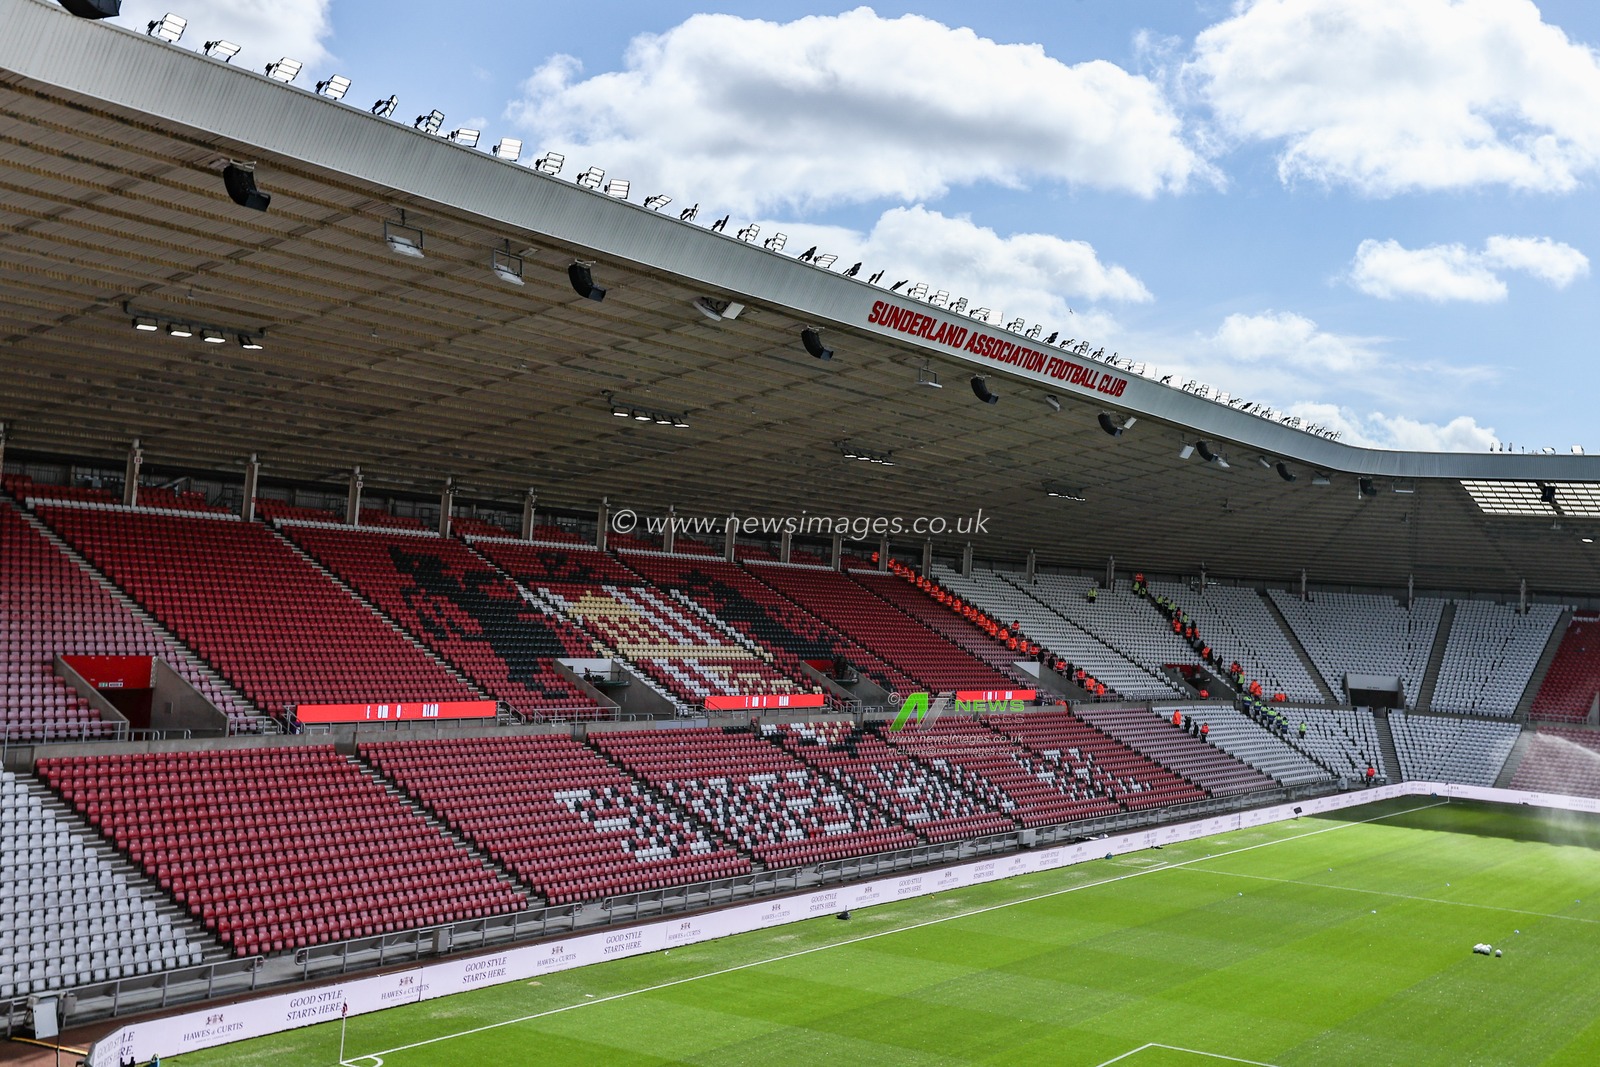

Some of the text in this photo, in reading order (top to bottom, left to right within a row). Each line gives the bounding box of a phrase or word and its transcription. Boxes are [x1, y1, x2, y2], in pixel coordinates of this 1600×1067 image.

[868, 300, 1128, 397] SUNDERLAND ASSOCIATION FOOTBALL CLUB
[811, 896, 824, 904] GOOD
[606, 930, 643, 944] GOOD STYLE
[604, 944, 625, 955] STARTS
[465, 956, 507, 972] GOOD STYLE
[537, 958, 555, 967] HAWES
[558, 953, 577, 963] CURTIS
[462, 968, 507, 984] STARTS HERE.
[290, 989, 343, 1008] GOOD STYLE
[381, 990, 403, 1000] HAWES
[407, 983, 430, 994] CURTIS
[286, 1006, 317, 1021] STARTS
[183, 1028, 211, 1042] HAWES
[216, 1021, 244, 1034] CURTIS
